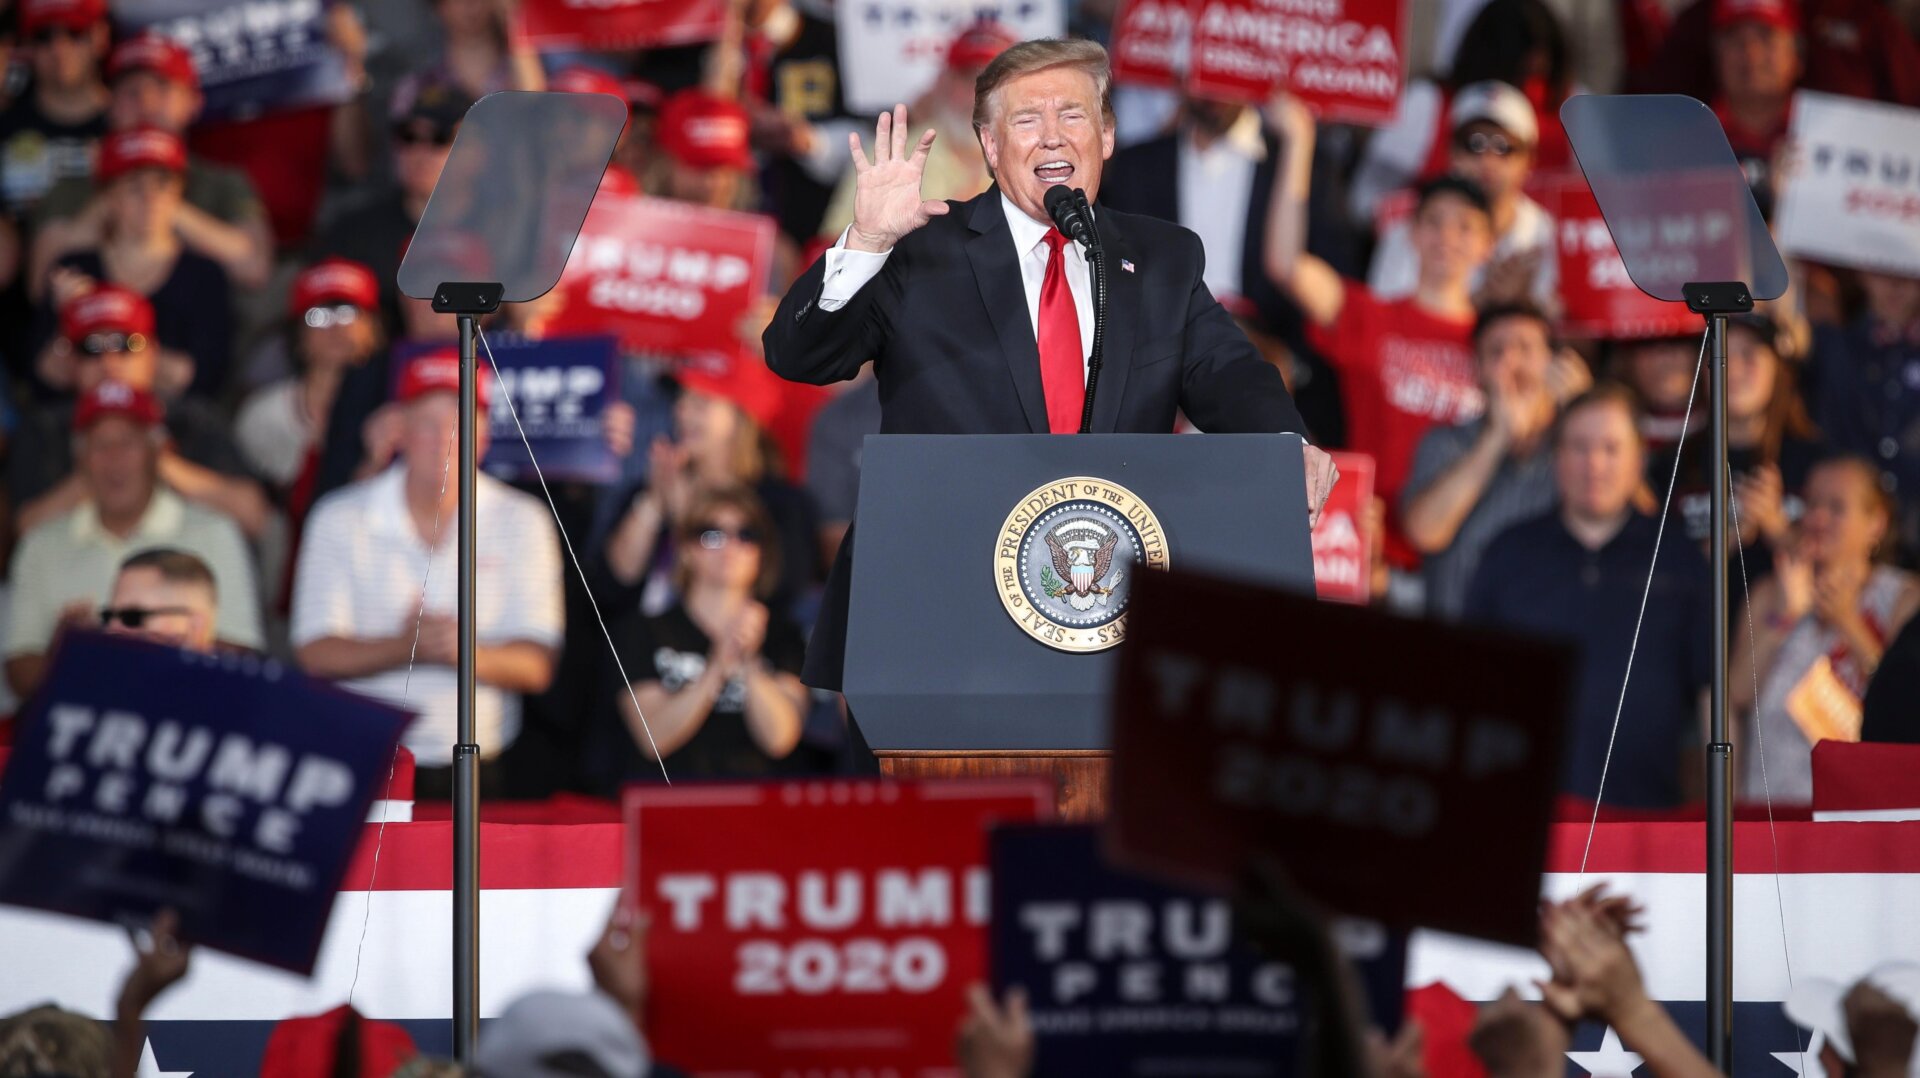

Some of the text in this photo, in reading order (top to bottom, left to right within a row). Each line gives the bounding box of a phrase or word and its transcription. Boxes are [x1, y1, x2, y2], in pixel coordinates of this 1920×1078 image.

[1204, 3, 1395, 62] AMERICA
[1814, 142, 1920, 188] TRU
[1561, 209, 1732, 257] TRUMP
[563, 232, 749, 292] TRUMP
[588, 277, 705, 320] 2020
[1083, 484, 1100, 496] OF
[1102, 488, 1124, 506] THE
[1001, 483, 1077, 560] PRESIDENT
[1002, 565, 1017, 590] THE
[1008, 590, 1023, 608] OF
[1023, 607, 1066, 643] SEAL
[1146, 650, 1530, 782] TRUMP
[48, 704, 355, 813] TRUMP
[45, 764, 302, 853] PENCE
[1214, 743, 1439, 840] 2020
[1019, 899, 1387, 959] TRUP
[735, 935, 948, 995] 2020
[1053, 961, 1297, 1005] PENC
